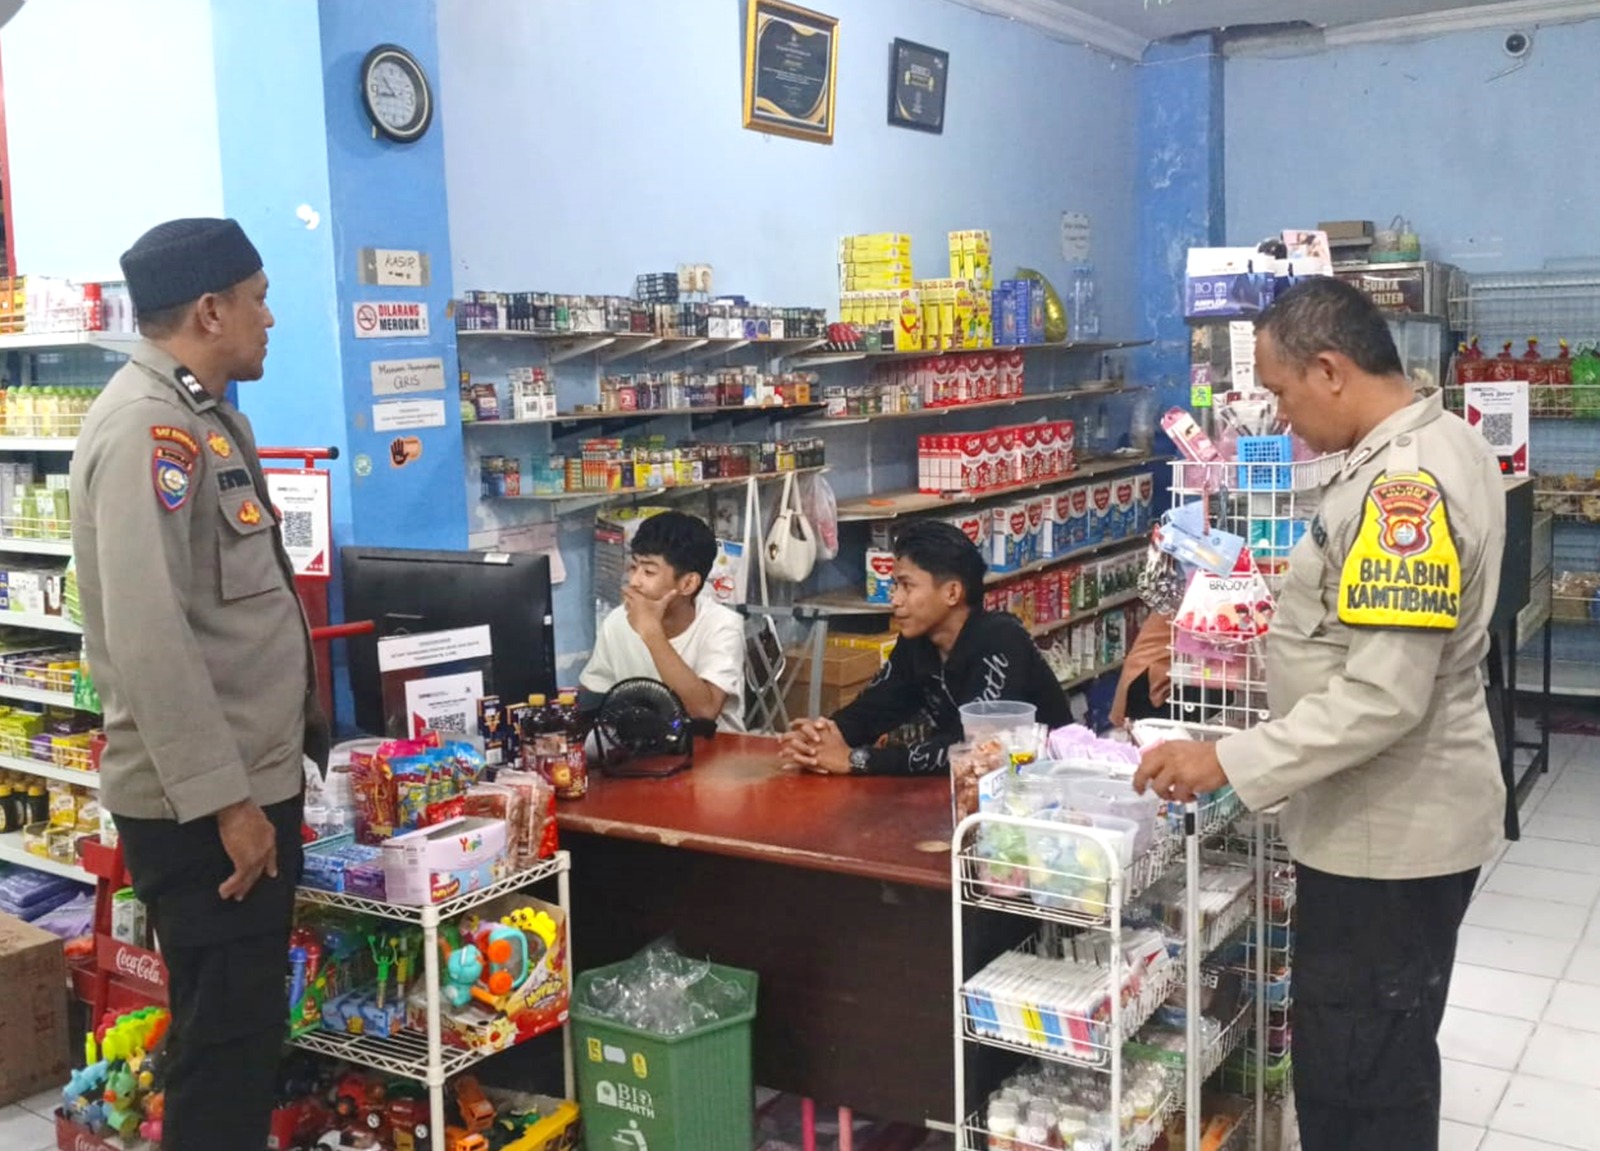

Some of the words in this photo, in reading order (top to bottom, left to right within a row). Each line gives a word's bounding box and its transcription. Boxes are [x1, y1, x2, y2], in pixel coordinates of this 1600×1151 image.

[385, 254, 416, 270] KASIR
[378, 303, 420, 317] DILARANG
[379, 318, 420, 331] MEROKOK
[1360, 558, 1449, 589] BHABIN
[1346, 584, 1458, 617] KAMTIBMAS
